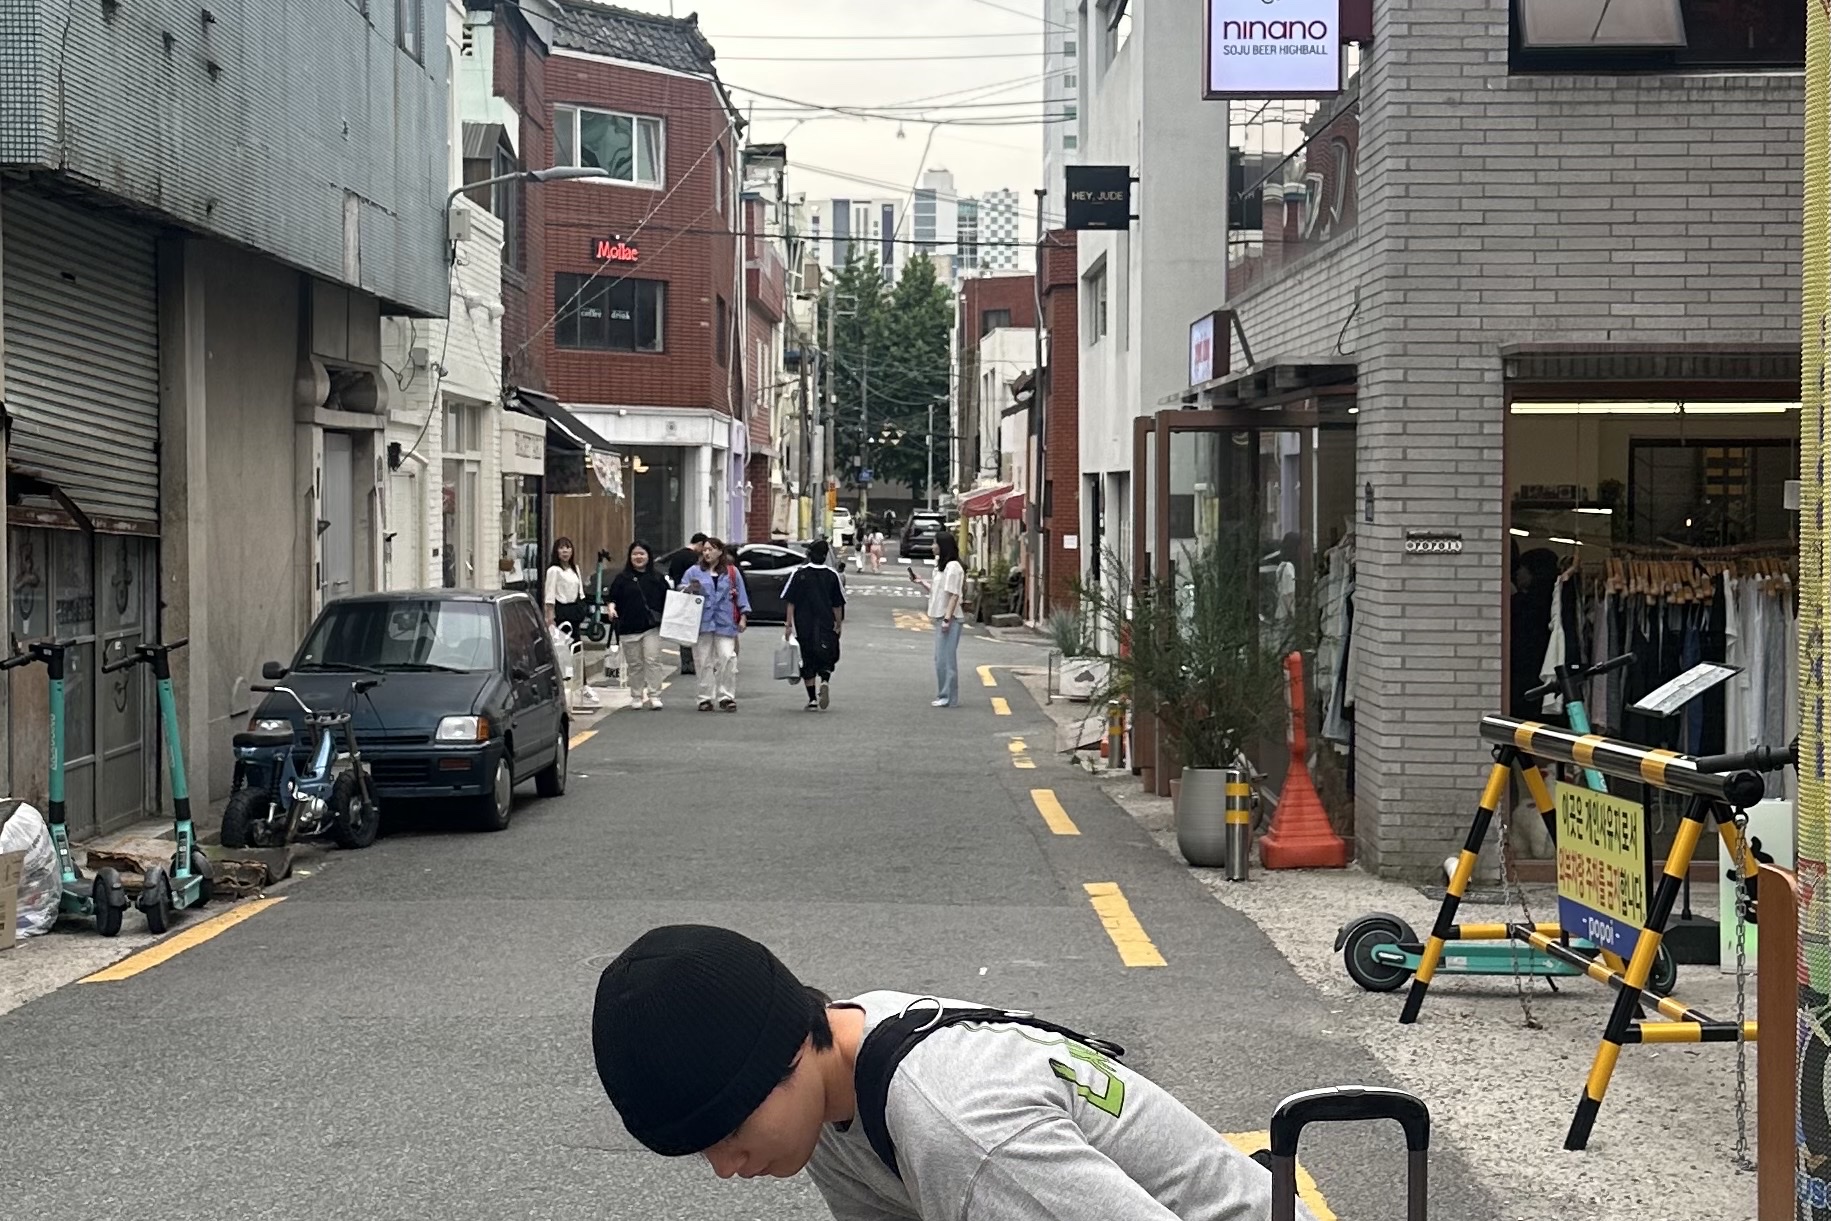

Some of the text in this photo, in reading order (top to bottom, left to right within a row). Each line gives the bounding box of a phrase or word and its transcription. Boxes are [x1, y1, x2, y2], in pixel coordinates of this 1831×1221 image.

[1223, 20, 1328, 40] ninano
[1223, 44, 1328, 56] SOJU BEER HIGHBALL
[1097, 191, 1124, 201] JUDE
[610, 308, 632, 320] drink
[1562, 791, 1583, 840] 이곳은
[1559, 847, 1585, 898] 외부차량
[1586, 856, 1606, 907] 주차를
